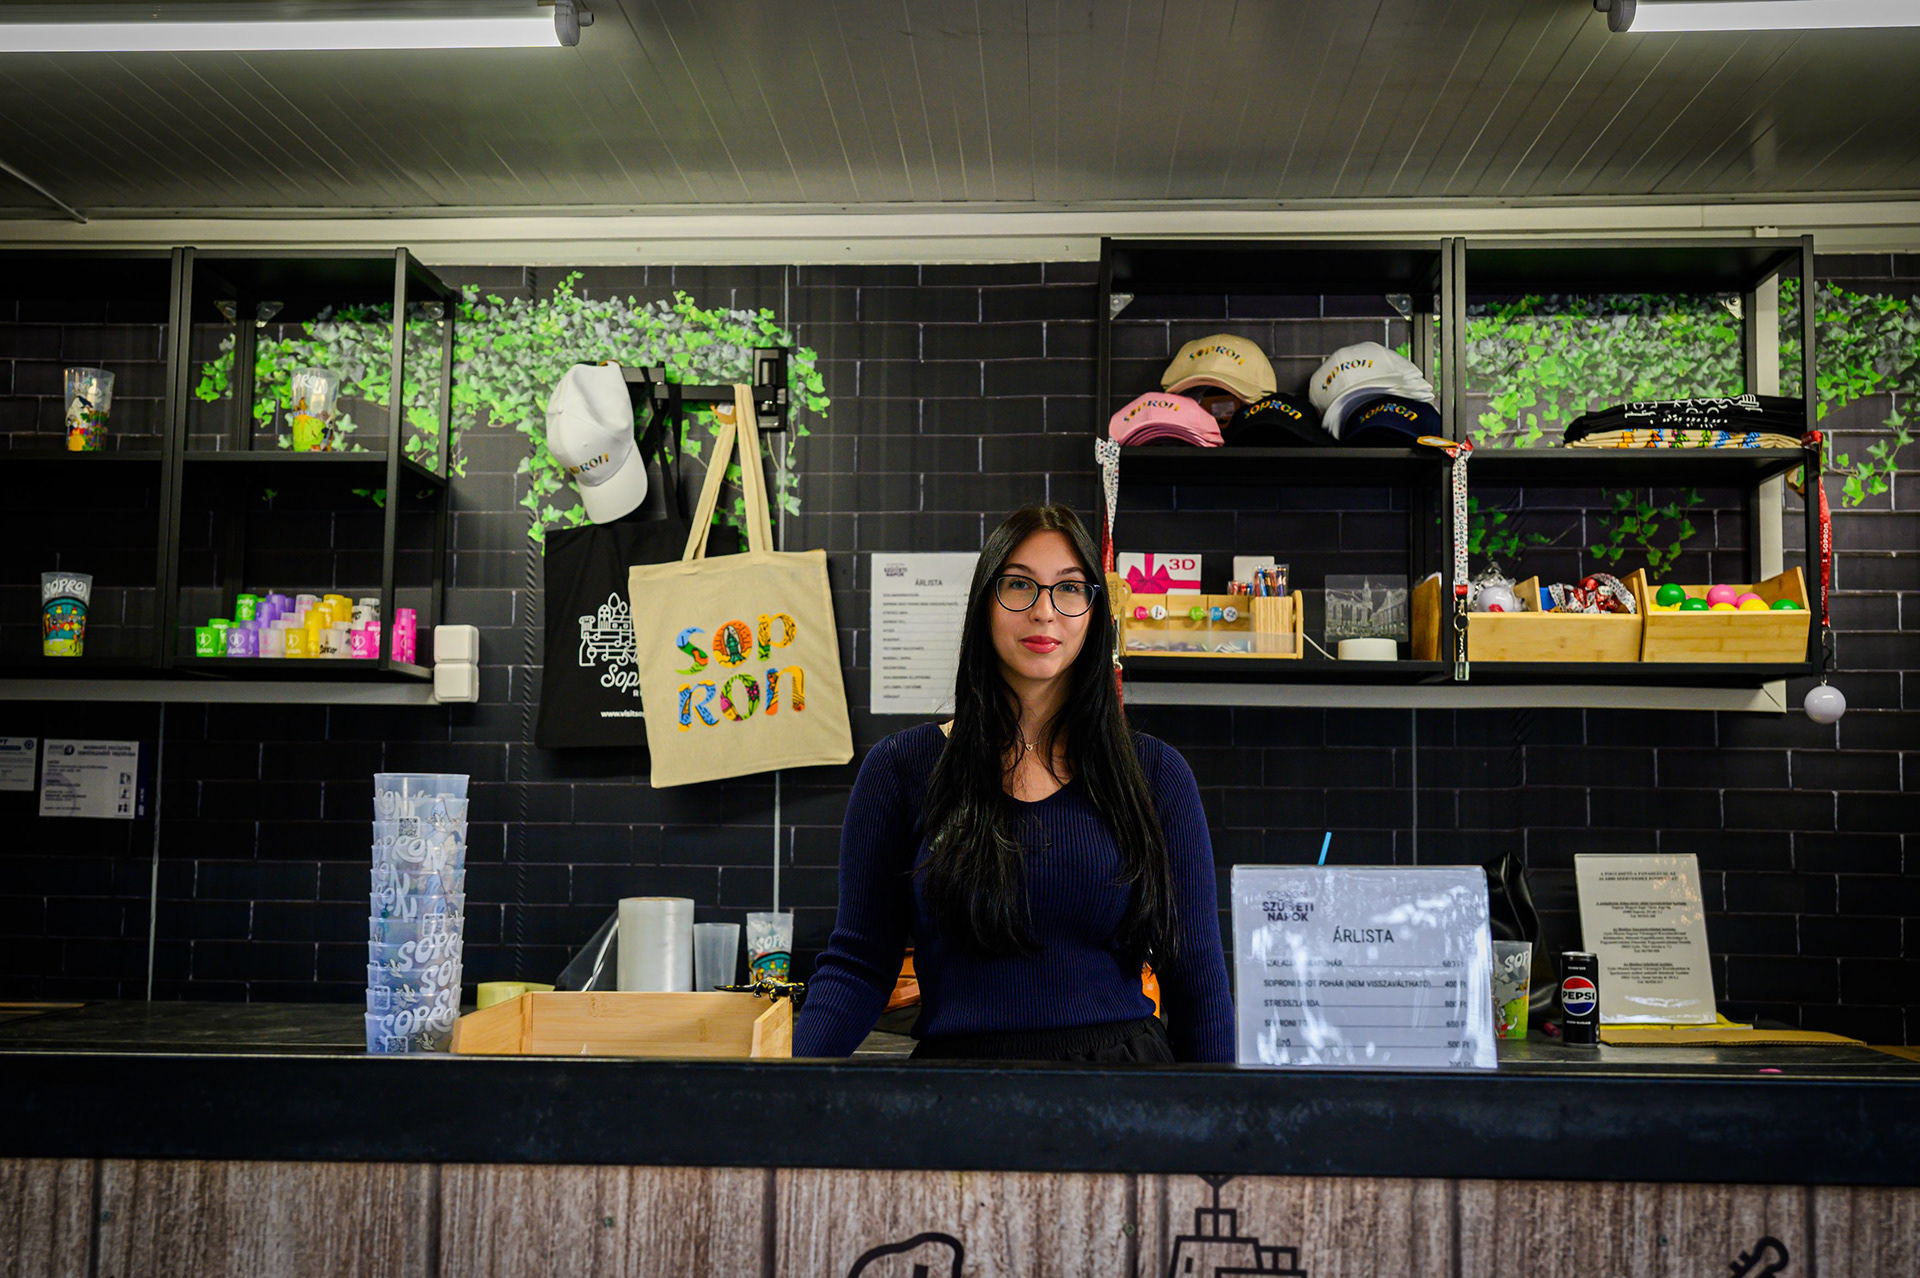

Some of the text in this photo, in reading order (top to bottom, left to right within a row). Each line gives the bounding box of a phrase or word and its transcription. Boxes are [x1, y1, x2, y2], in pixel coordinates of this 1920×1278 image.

[1168, 558, 1196, 571] 3D
[1262, 899, 1315, 912] SZÜETI
[1332, 925, 1395, 943] ÁRLISTA
[1319, 978, 1344, 988] POHÁR
[1563, 991, 1595, 1001] PEPSI
